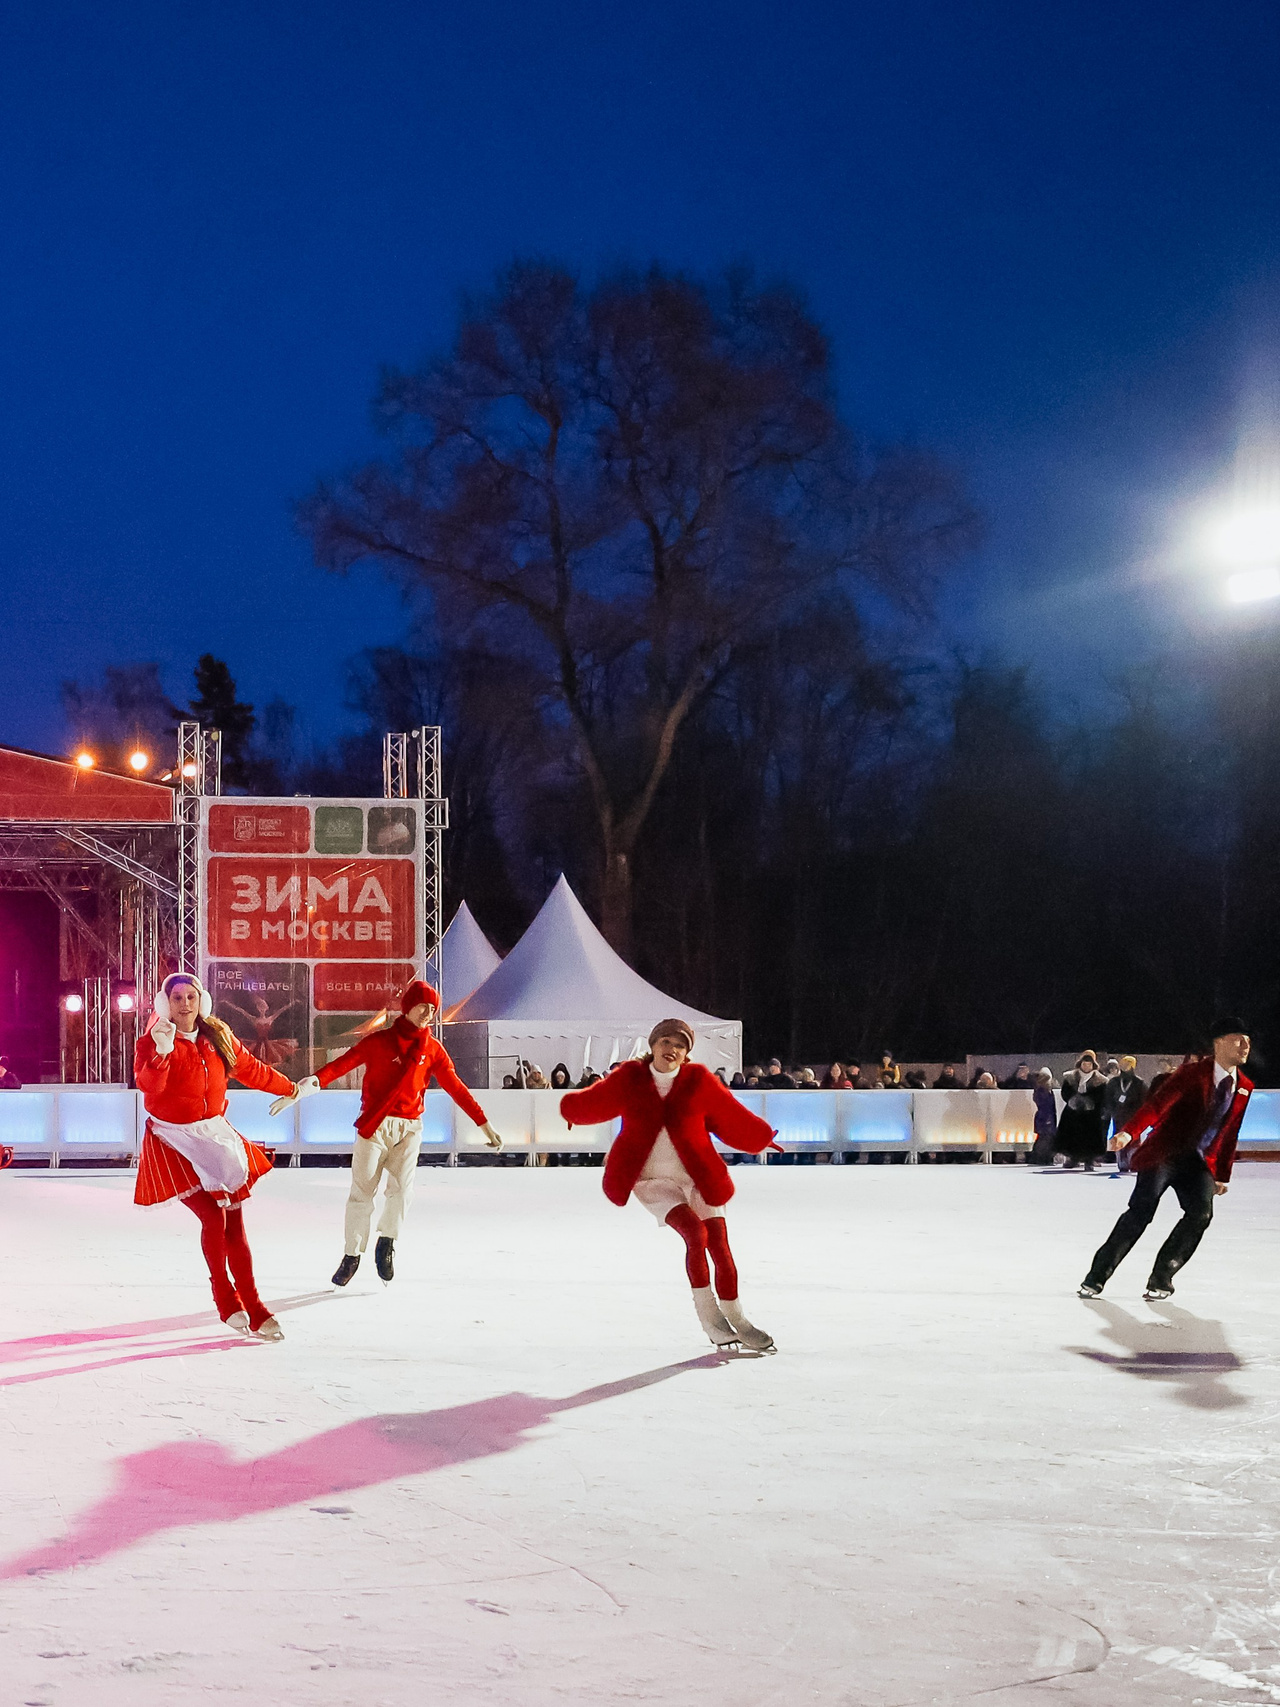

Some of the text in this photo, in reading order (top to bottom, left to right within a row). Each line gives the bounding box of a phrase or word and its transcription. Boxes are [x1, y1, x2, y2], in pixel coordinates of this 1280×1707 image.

[230, 874, 393, 914] ЗИМА
[230, 919, 393, 941] В МОСКВЕ
[217, 970, 243, 980] ВСЕ
[326, 982, 351, 991] ВСЕ
[354, 982, 363, 991] В
